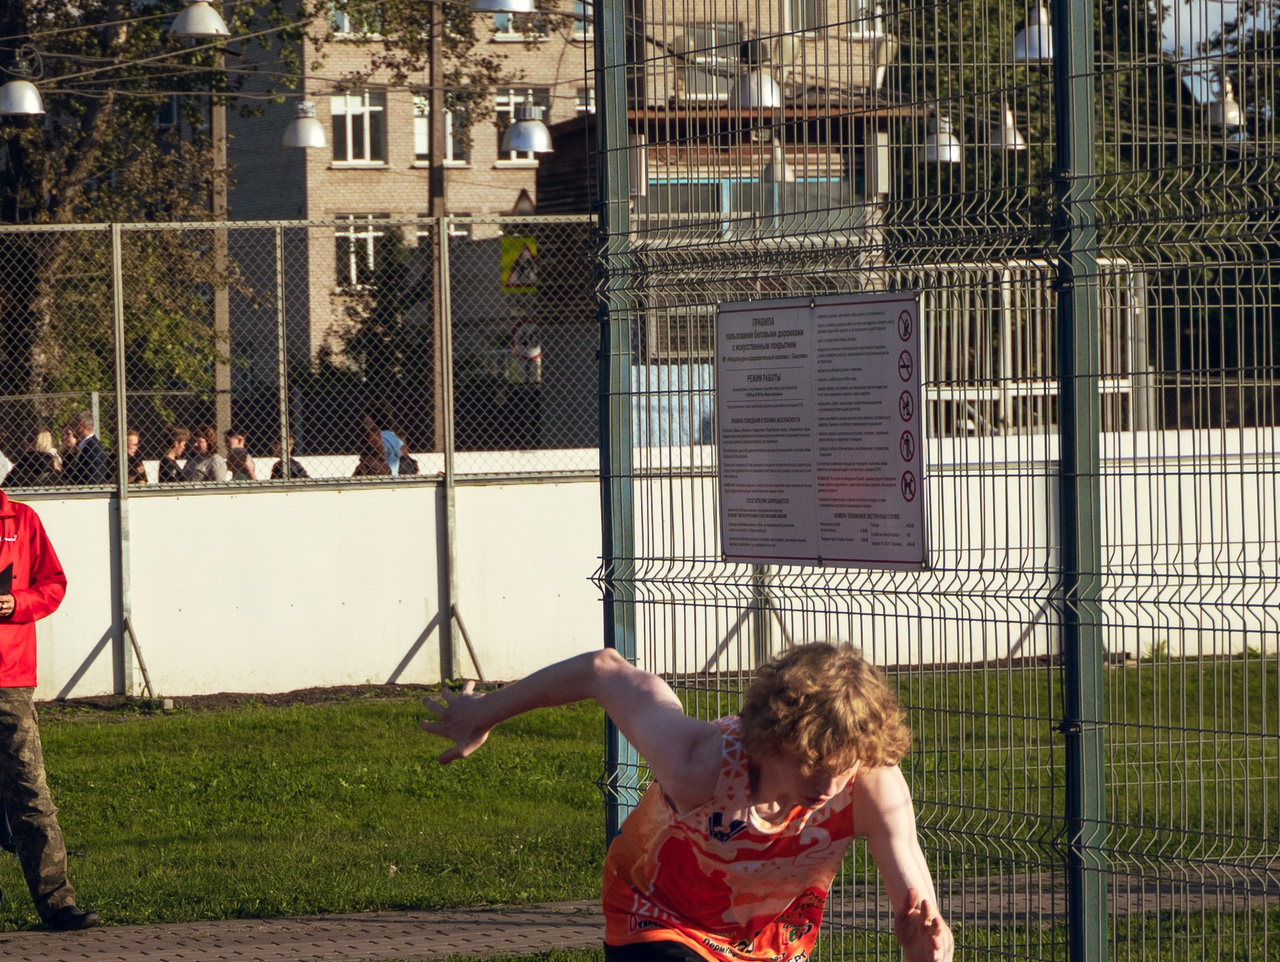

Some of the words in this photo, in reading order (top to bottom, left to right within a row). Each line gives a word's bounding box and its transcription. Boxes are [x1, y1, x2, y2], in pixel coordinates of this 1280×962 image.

[752, 317, 775, 327] ПРАВИЛА
[725, 331, 754, 340] пользования
[754, 329, 777, 339] беговыми
[777, 329, 804, 339] дорожками
[736, 342, 770, 353] искусственным
[770, 341, 797, 351] покрытием
[746, 374, 762, 383] РЕЖИМ
[762, 373, 782, 382] РАБОТЫ
